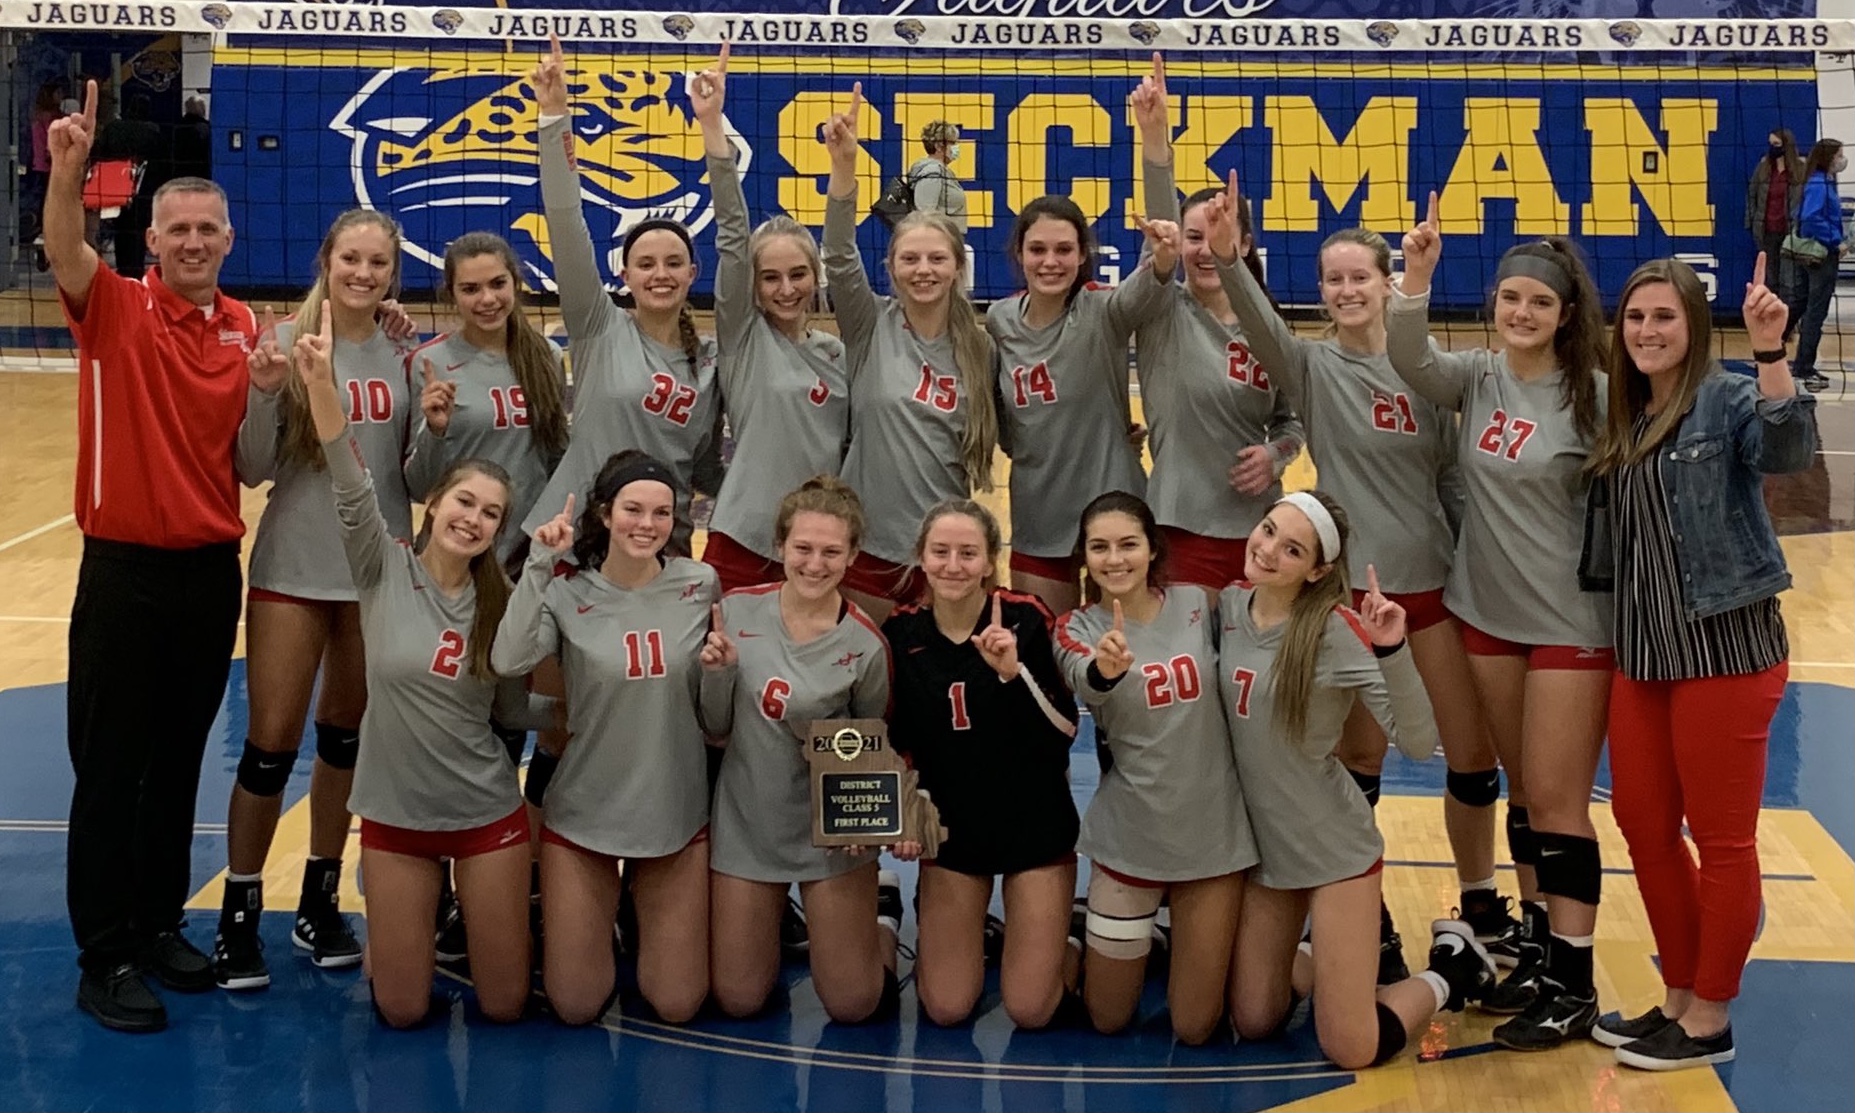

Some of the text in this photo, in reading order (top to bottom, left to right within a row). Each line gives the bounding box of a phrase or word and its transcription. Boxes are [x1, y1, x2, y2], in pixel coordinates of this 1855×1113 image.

[27, 2, 177, 27] JAGUARS
[258, 9, 407, 33] JAGUARS
[488, 15, 637, 39] JAGUARS
[720, 20, 868, 43] JAGUARS
[951, 23, 1103, 44] JAGUARS
[1187, 24, 1340, 46] JAGUARS
[1426, 25, 1582, 46] JAGUARS
[1670, 25, 1828, 46] JAGUARS
[778, 92, 1718, 237] SECKMAN
[913, 361, 959, 413] 15
[1011, 359, 1057, 408] 14
[1226, 340, 1270, 392] 22
[346, 378, 394, 424] 10
[489, 385, 530, 429] 19
[642, 372, 698, 427] 32
[1371, 390, 1418, 435] 21
[1476, 408, 1537, 463] 27
[428, 629, 466, 680] 2
[623, 629, 667, 680] 11
[760, 677, 792, 721] 6
[1141, 654, 1203, 710] 20
[1232, 667, 1257, 718] 7
[948, 682, 971, 730] 1
[816, 737, 833, 750] 20
[863, 736, 879, 750] 21
[830, 795, 891, 804] VOLLEYBALL
[840, 781, 881, 790] DISTRICT
[834, 818, 889, 827] FIRST PLACE
[842, 804, 872, 812] CLASS
